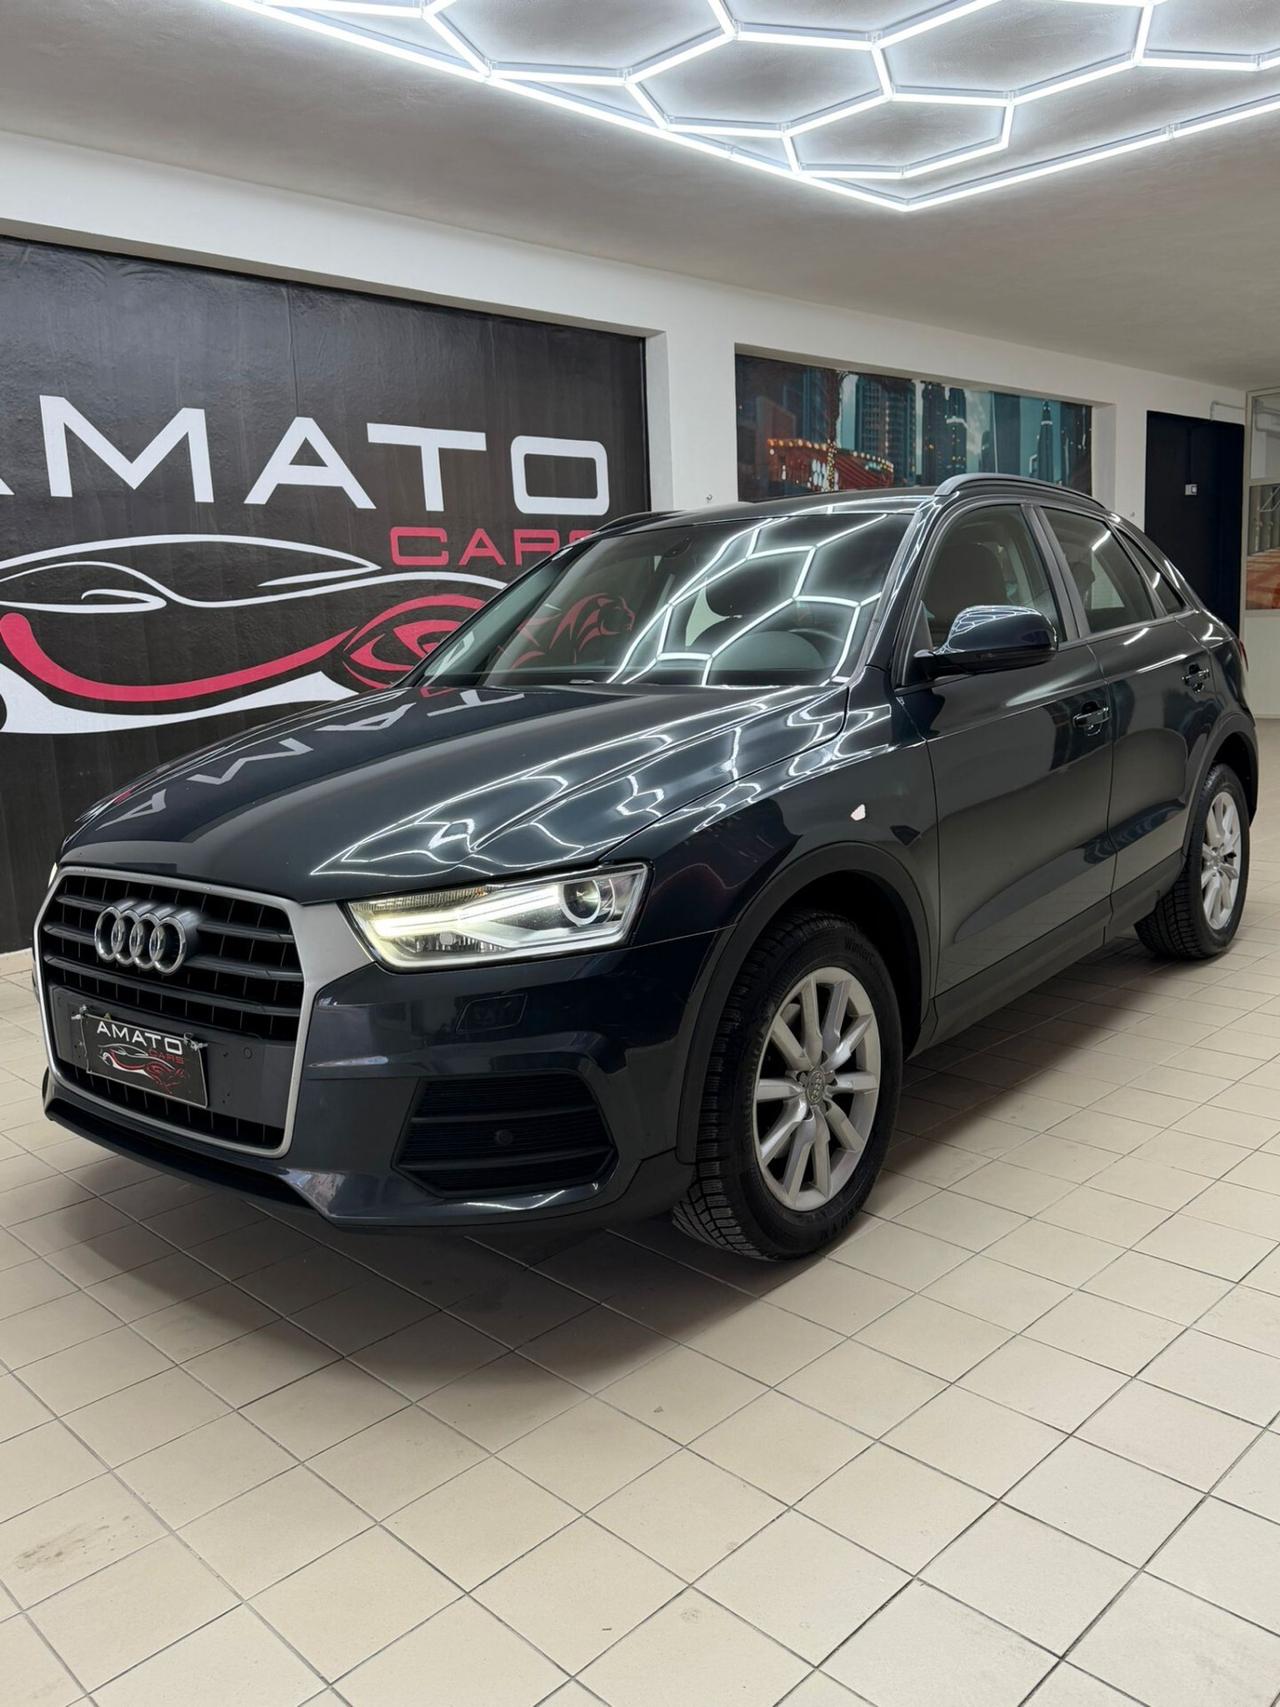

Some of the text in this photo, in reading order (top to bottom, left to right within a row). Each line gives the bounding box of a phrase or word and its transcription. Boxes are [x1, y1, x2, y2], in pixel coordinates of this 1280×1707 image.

[0, 395, 609, 516] MATO
[97, 1021, 183, 1055] AMATO
[148, 1049, 184, 1064] CARS
